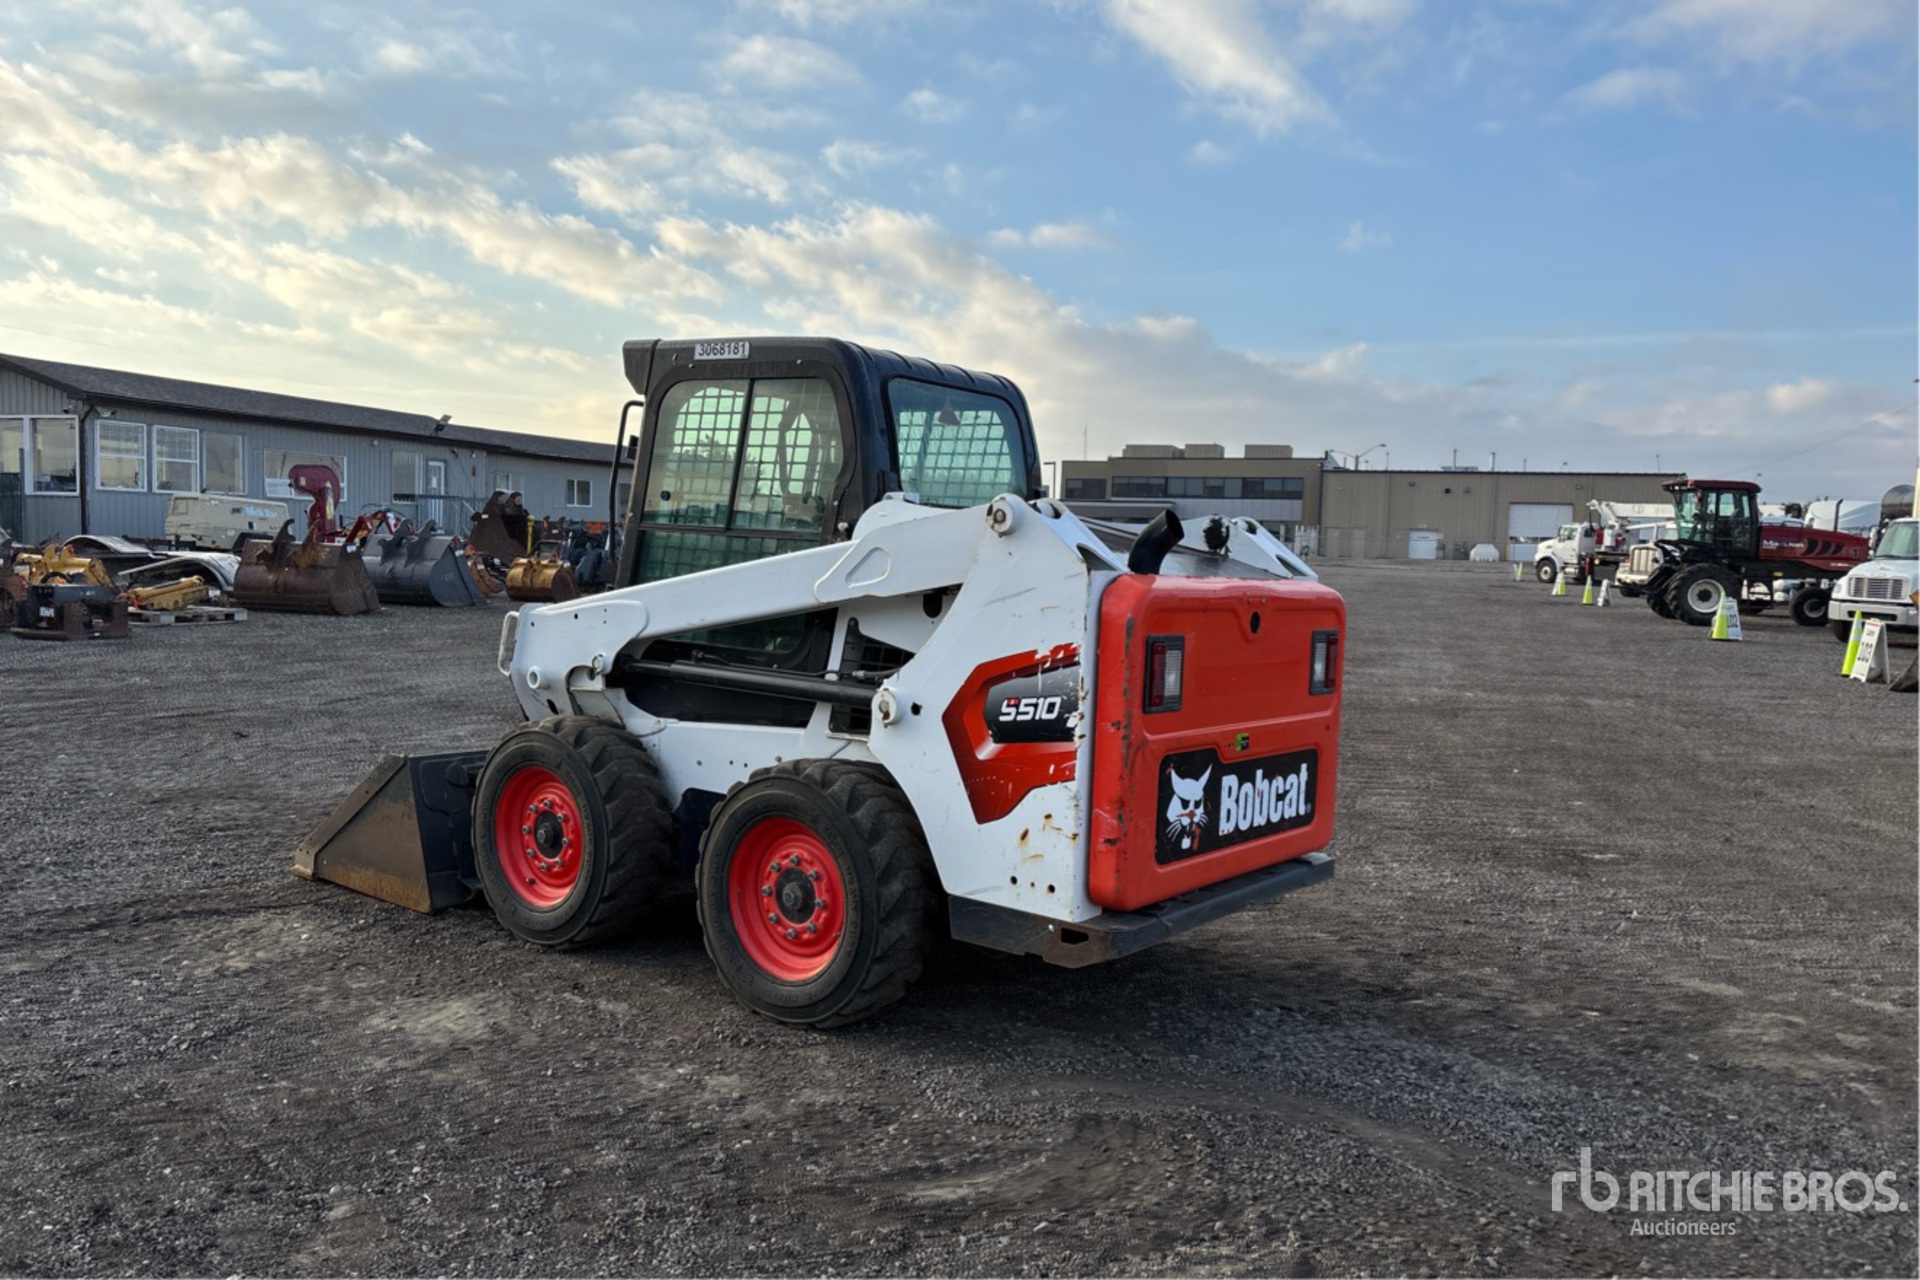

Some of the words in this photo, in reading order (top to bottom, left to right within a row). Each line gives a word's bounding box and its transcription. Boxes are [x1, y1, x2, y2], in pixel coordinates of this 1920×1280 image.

[698, 342, 746, 357] 3068181
[999, 696, 1061, 721] S510
[1219, 763, 1308, 836] Bobcat
